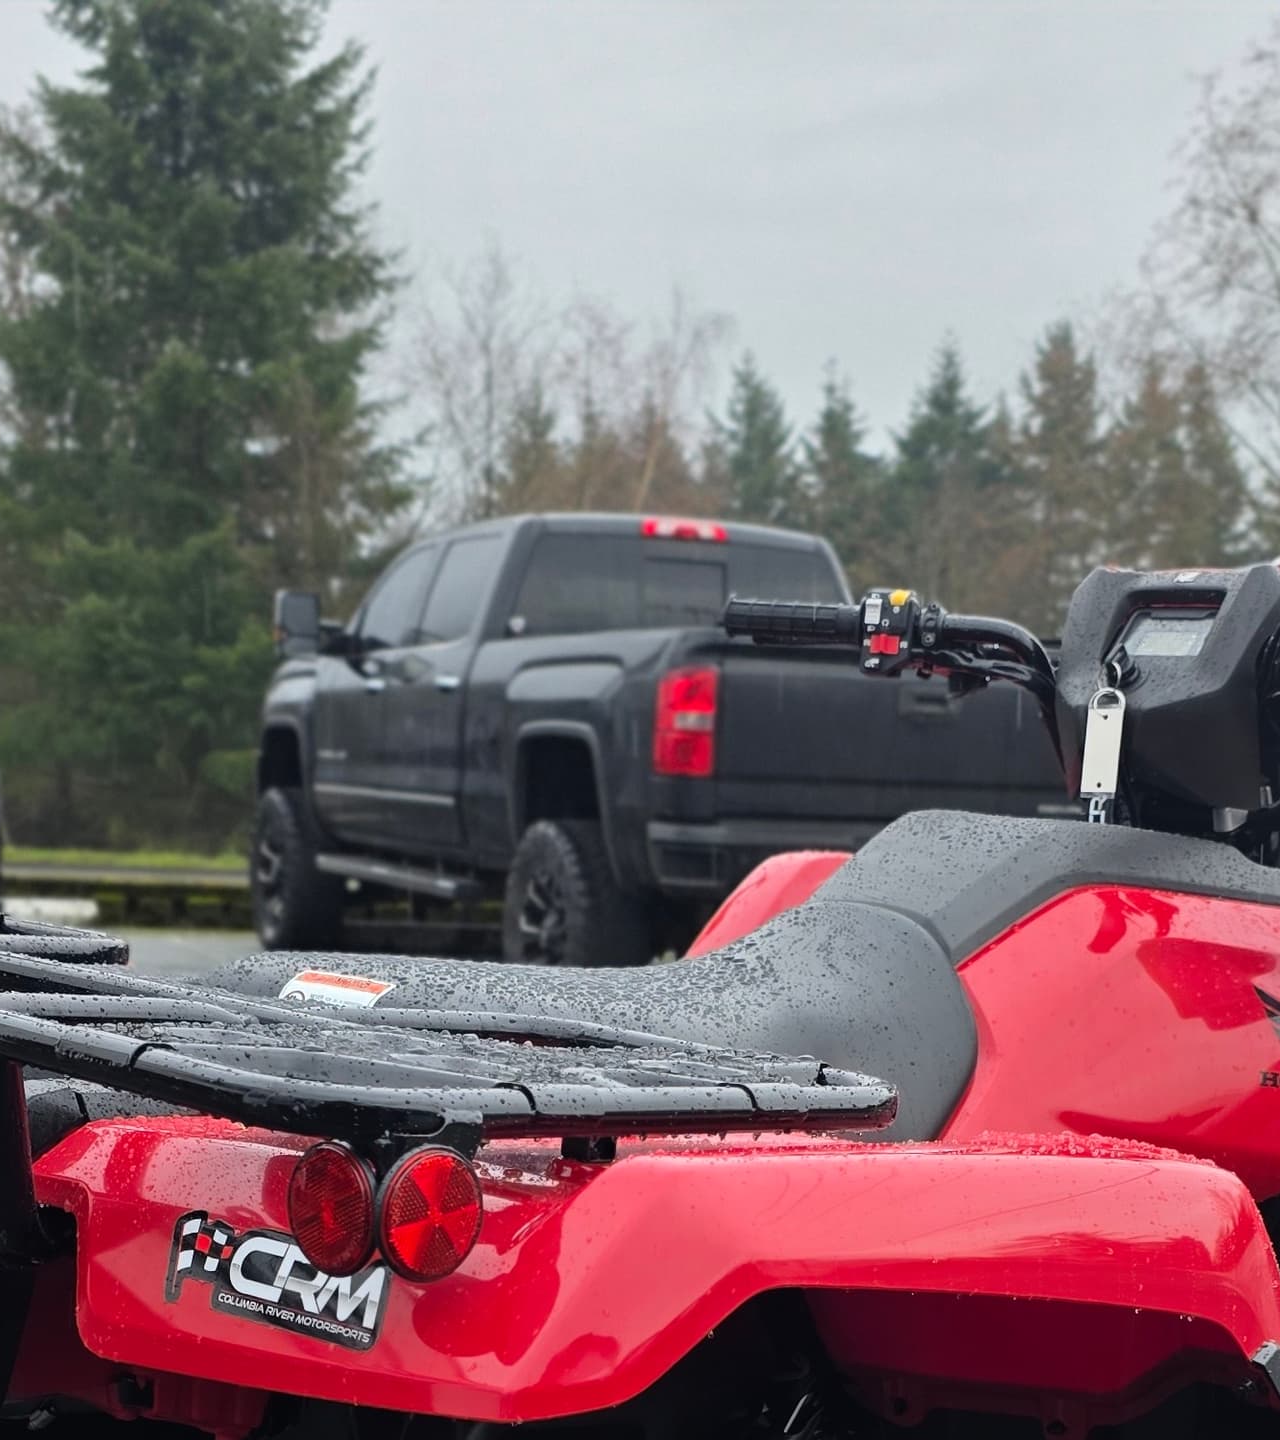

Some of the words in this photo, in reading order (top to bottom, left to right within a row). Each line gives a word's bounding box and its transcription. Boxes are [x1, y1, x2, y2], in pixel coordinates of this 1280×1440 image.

[218, 1293, 265, 1315] COLUMBIA
[265, 1305, 296, 1322] RIVER
[295, 1315, 372, 1344] MOTORSPORTS
[229, 1236, 386, 1330] CRM
